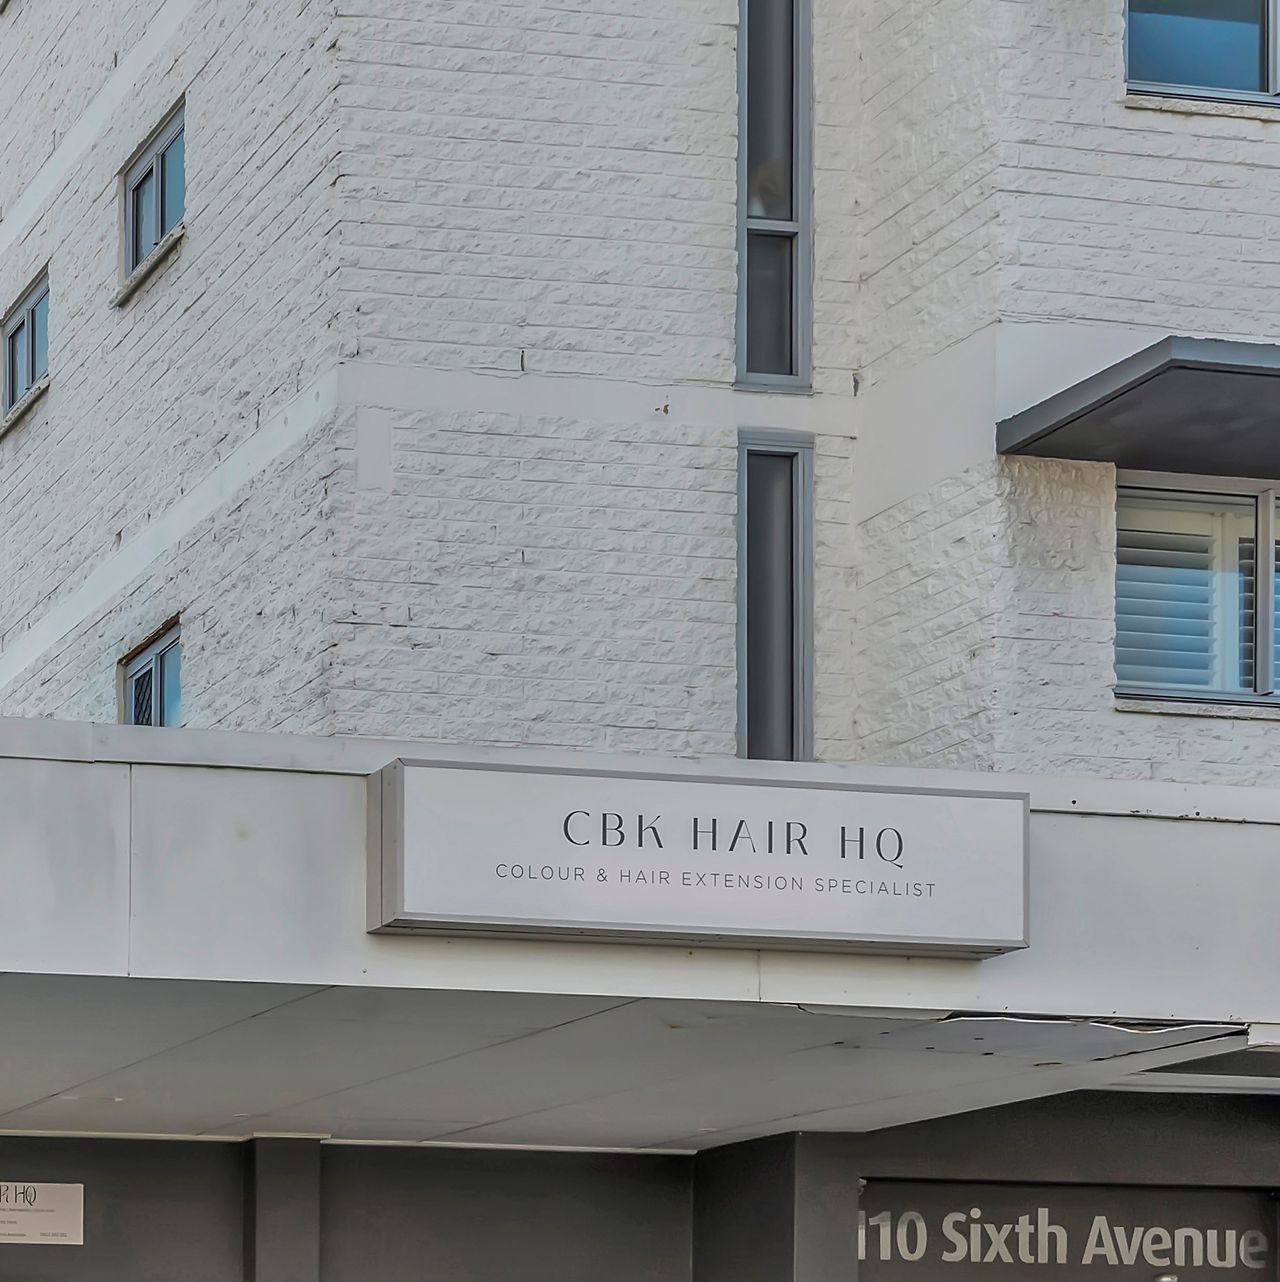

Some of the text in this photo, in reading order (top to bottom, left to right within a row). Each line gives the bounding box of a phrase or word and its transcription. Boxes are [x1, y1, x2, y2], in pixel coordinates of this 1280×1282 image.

[562, 810, 906, 869] CBK HAIR HQ
[495, 863, 937, 898] COLOUR & HAIR EXTENSION SPECIALIST
[14, 1185, 37, 1206] HQ
[857, 1207, 1268, 1269] 110 Sixth Avenue
